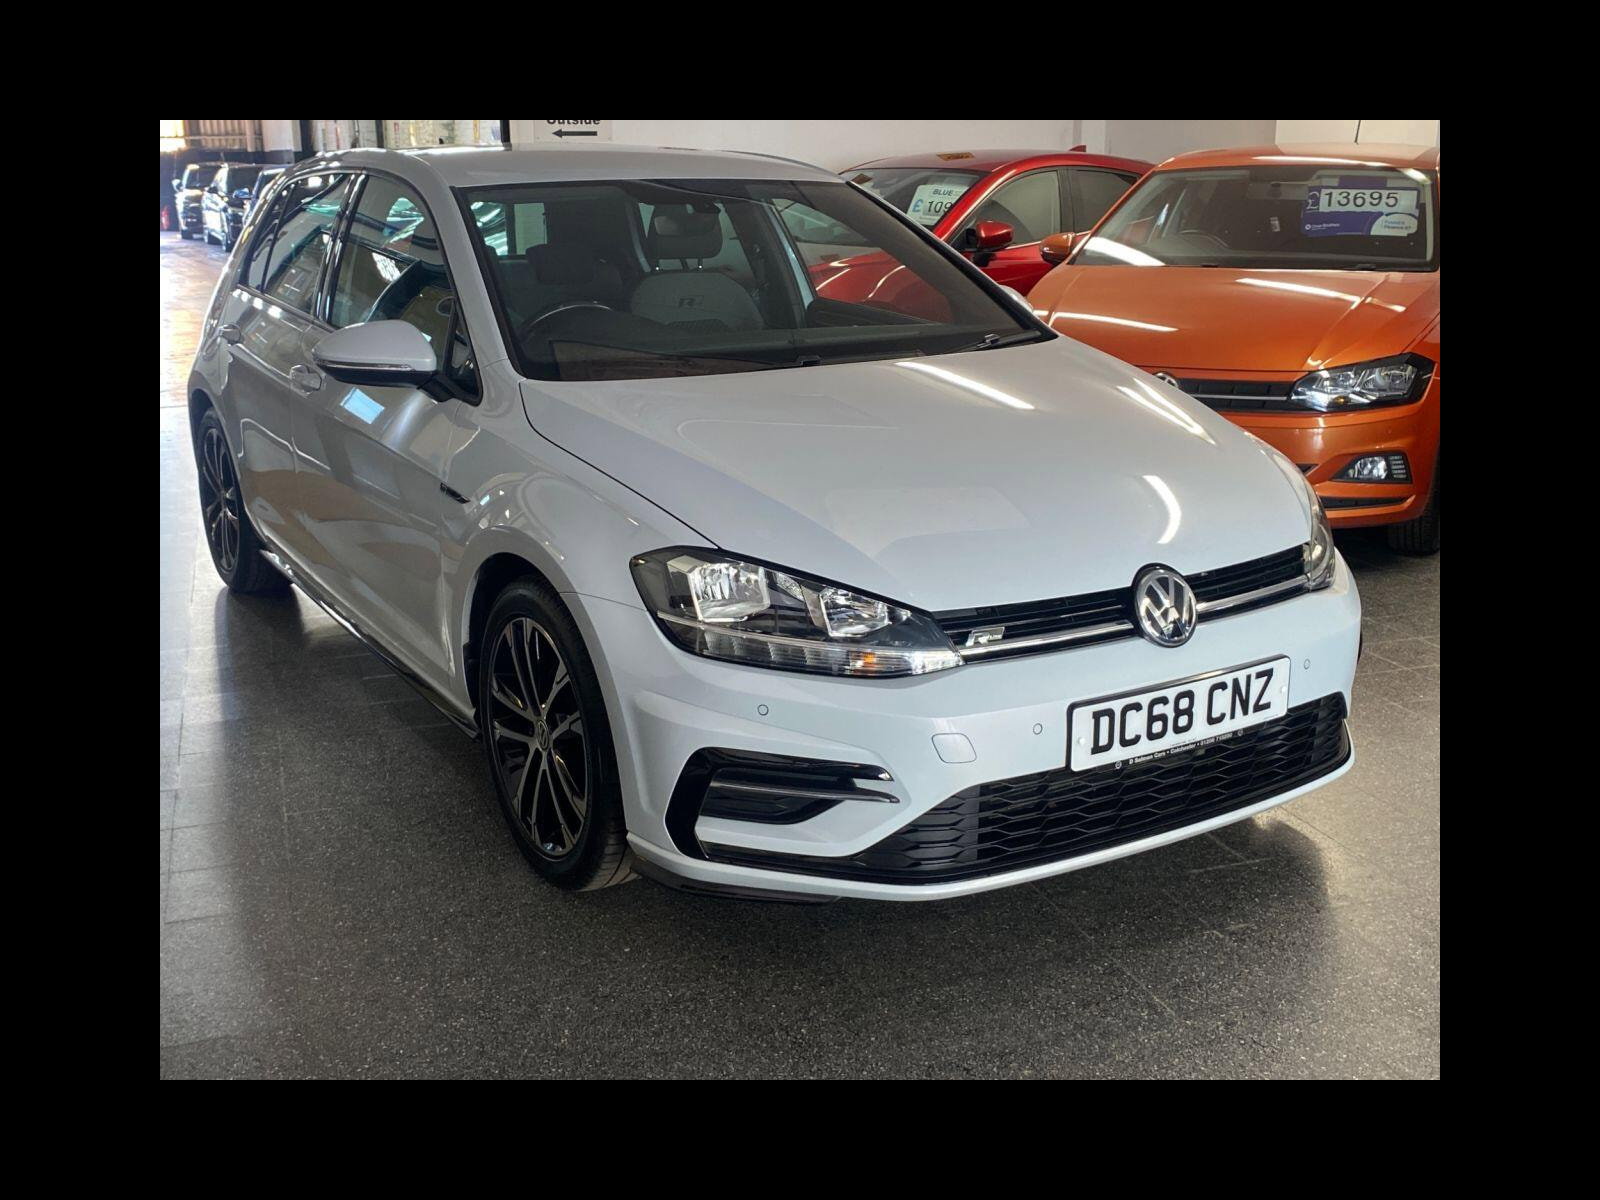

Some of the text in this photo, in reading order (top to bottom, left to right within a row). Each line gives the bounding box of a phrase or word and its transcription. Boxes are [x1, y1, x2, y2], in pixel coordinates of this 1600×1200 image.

[932, 188, 953, 196] BLUE
[1090, 667, 1274, 755] DC68 CNZ
